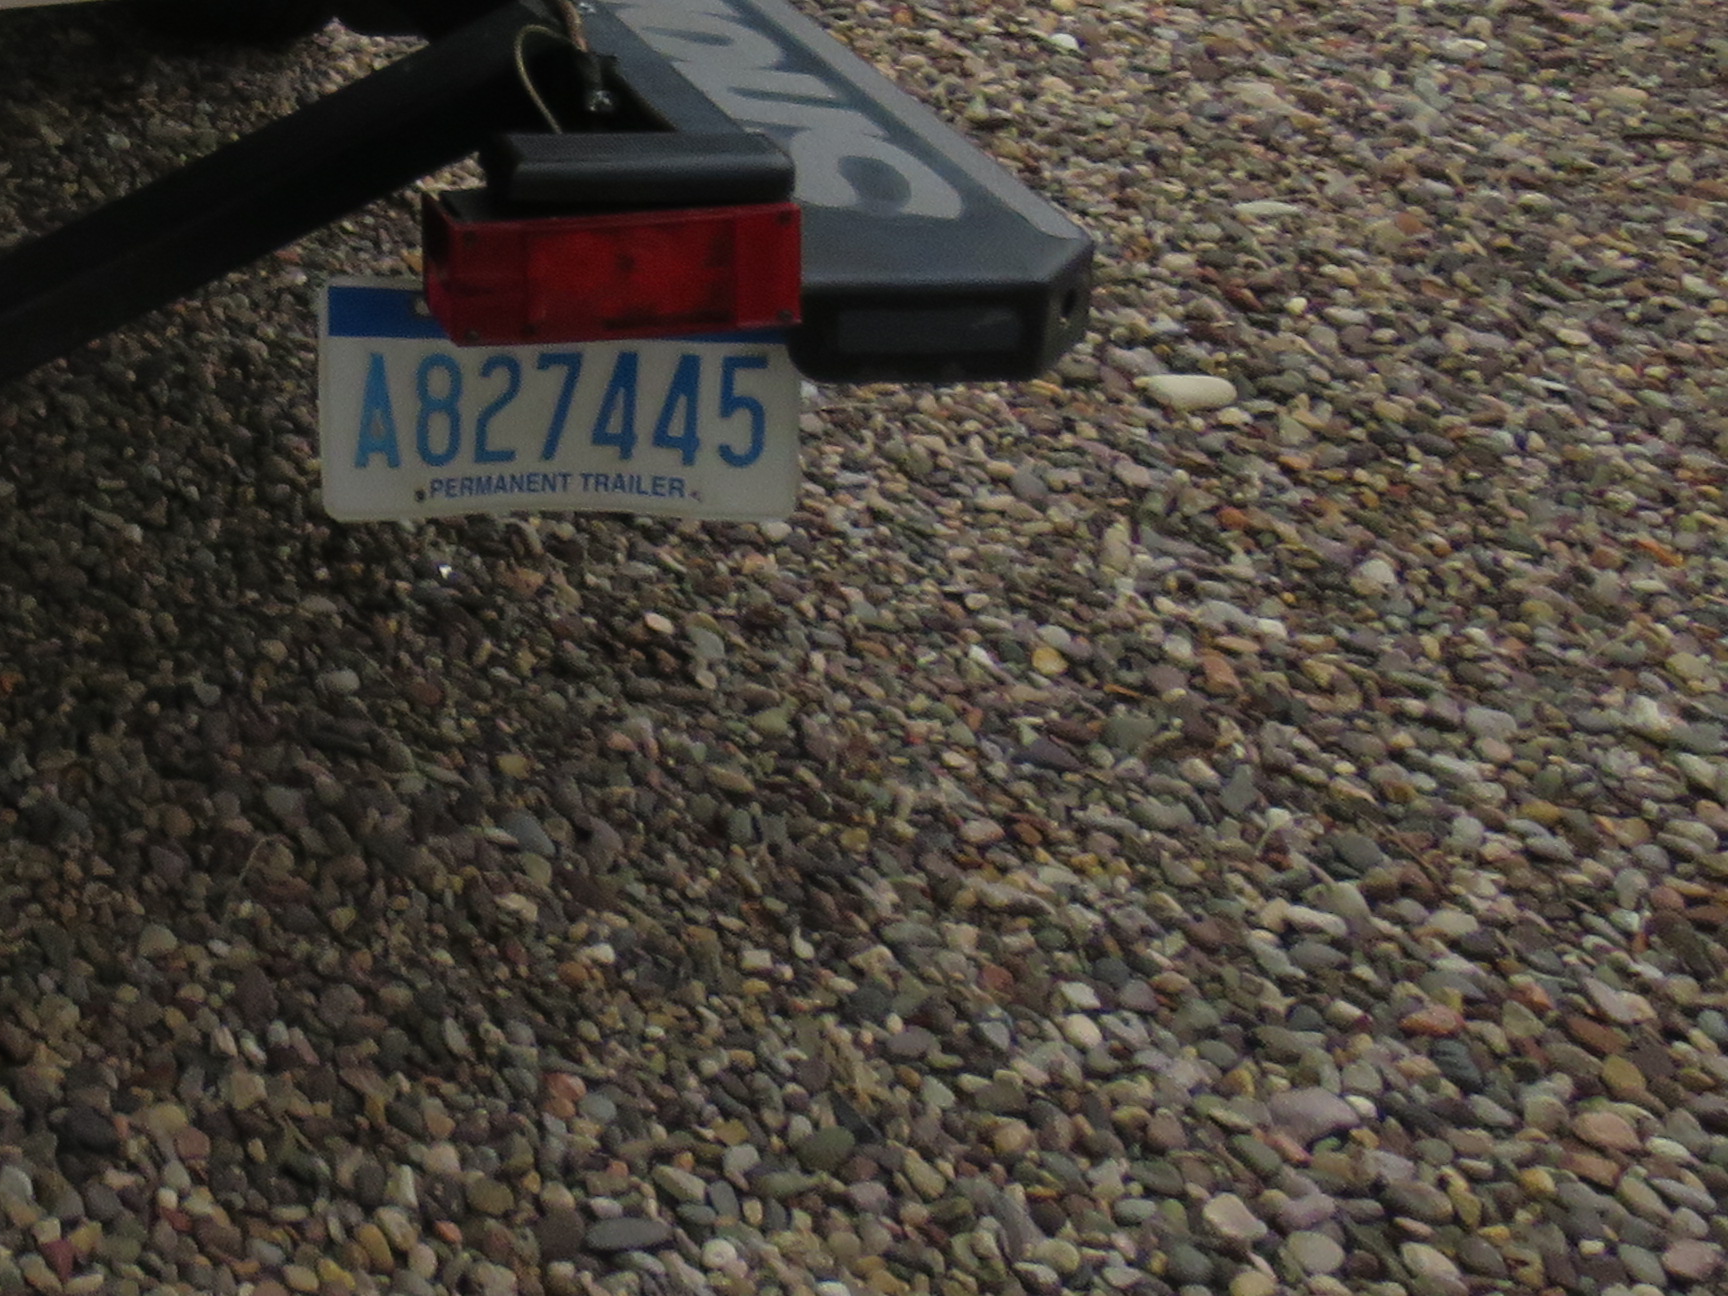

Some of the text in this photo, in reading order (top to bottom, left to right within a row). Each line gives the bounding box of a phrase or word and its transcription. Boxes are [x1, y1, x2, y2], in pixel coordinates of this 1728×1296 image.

[354, 351, 769, 468] A827445
[430, 472, 686, 498] PERMANENT TRAILER
